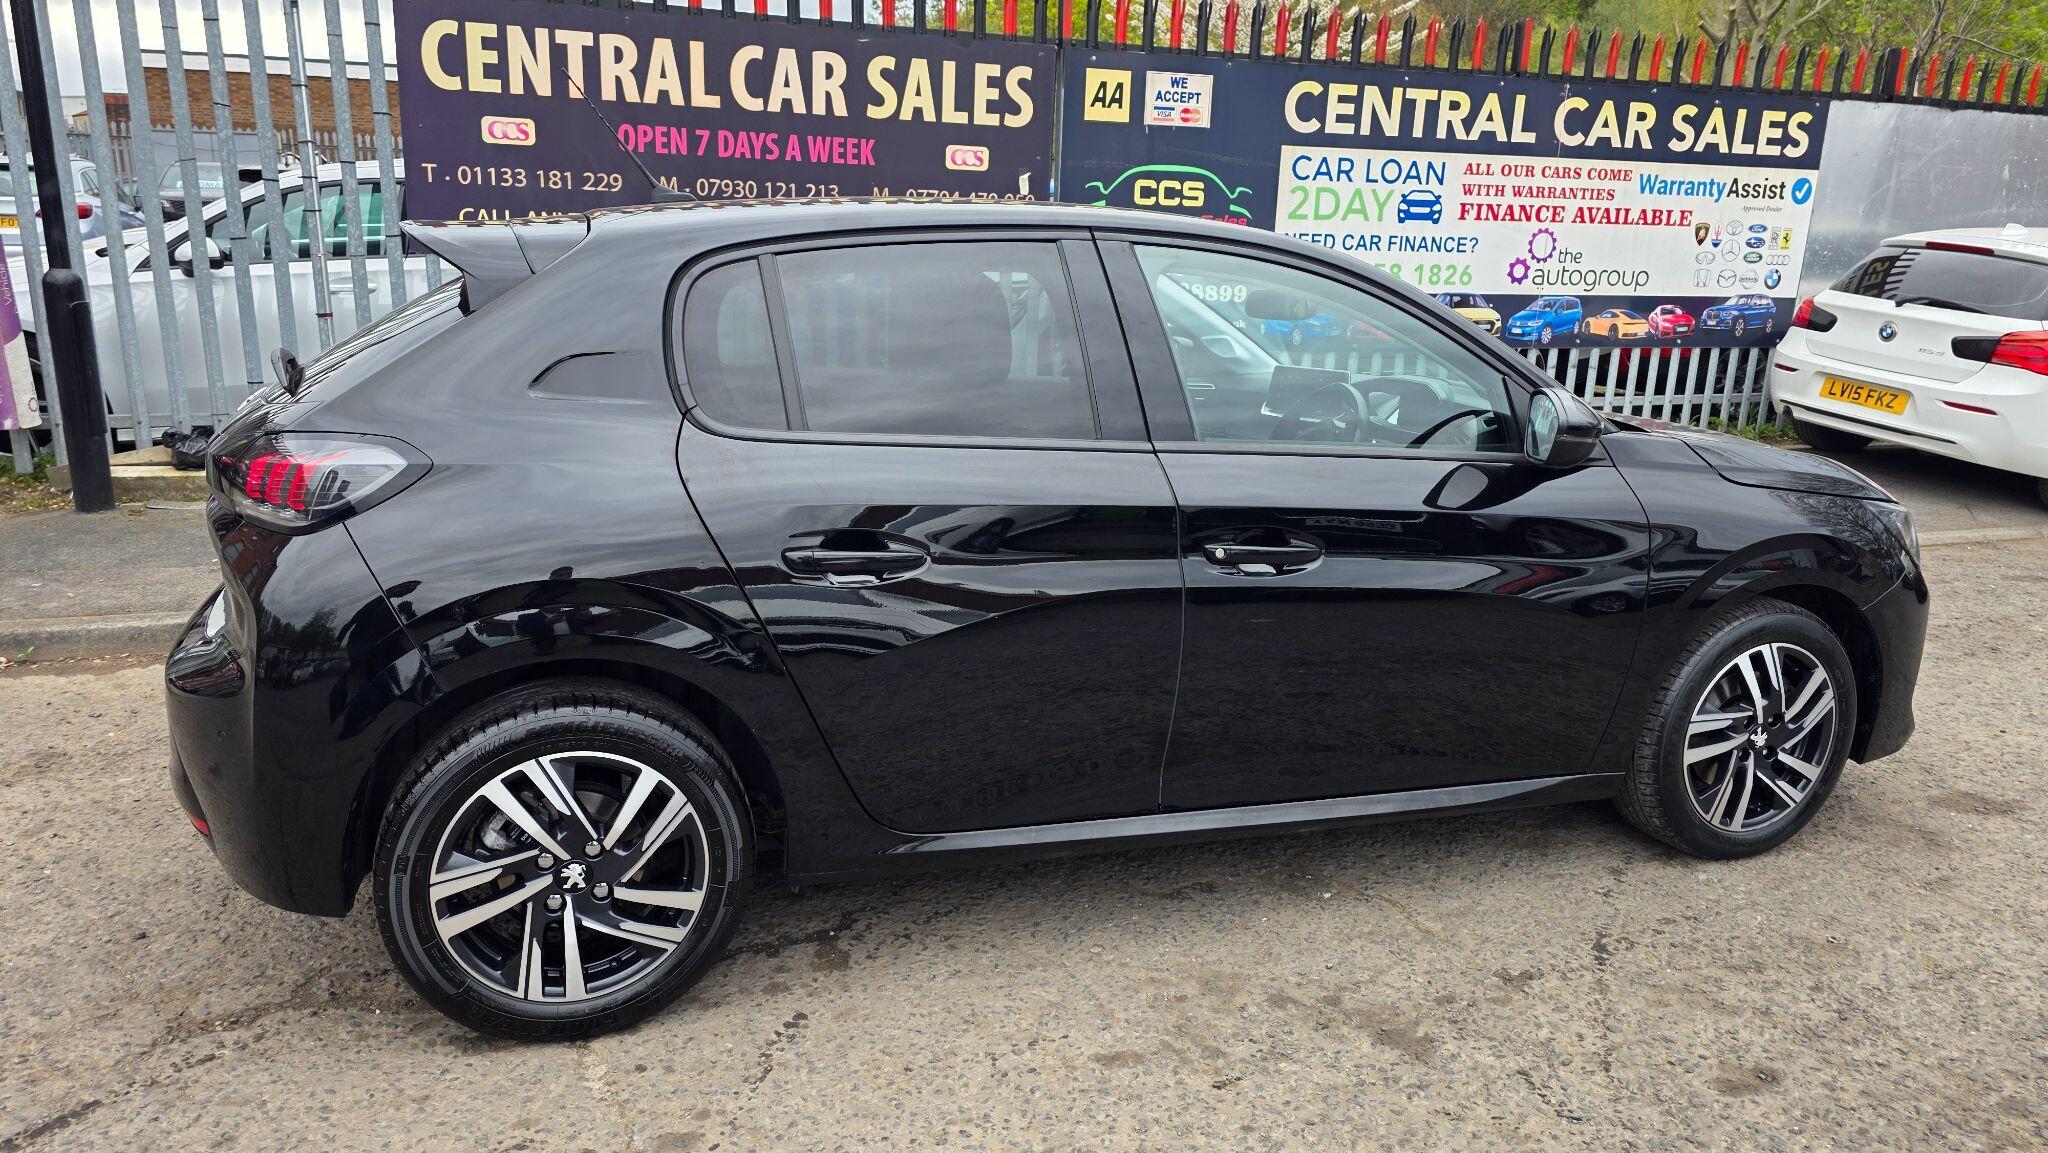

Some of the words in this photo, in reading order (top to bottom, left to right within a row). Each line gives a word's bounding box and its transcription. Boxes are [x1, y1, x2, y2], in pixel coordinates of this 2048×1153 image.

[421, 19, 721, 108] CENTRAL
[730, 45, 848, 117] CAR
[866, 55, 1034, 128] SALES
[1170, 77, 1188, 89] WE
[1090, 81, 1123, 109] AA
[1155, 90, 1201, 104] ACCEPT
[488, 121, 529, 141] CCS
[1284, 80, 1536, 144] CENTRAL
[1554, 97, 1657, 149] CAR
[1667, 103, 1814, 158] SALES
[618, 124, 688, 155] OPEN
[695, 130, 710, 156] 7
[718, 130, 778, 160] DAYS
[785, 134, 801, 162] A
[807, 136, 875, 165] WEEK
[950, 149, 984, 167] CCS
[1292, 155, 1354, 182] CAR
[1365, 159, 1446, 186] LOAN
[458, 166, 527, 187] 01133
[536, 170, 572, 190] 181
[582, 173, 623, 192] 229
[1463, 162, 1494, 177] ALL
[1501, 164, 1535, 178] OUR
[1541, 166, 1582, 180] CARS
[1587, 168, 1633, 182] COME
[696, 178, 757, 198] 07930
[764, 181, 796, 198] 121
[806, 183, 839, 198] 213
[1133, 179, 1205, 207] CCS
[1461, 183, 1505, 197] WITH
[1512, 185, 1616, 201] WARRANTIES
[1639, 174, 1786, 203] WarrantyAssist
[1287, 185, 1395, 222] 2DAY
[1458, 202, 1566, 223] FINANCE
[1571, 206, 1694, 227] AVAILABLE
[1342, 233, 1382, 251] CAR
[1387, 235, 1479, 253] FINANCE?
[1558, 247, 1583, 264] the
[1414, 264, 1473, 286] 1826
[1532, 265, 1649, 292] autogroup
[1828, 381, 1864, 401] LV15
[1865, 388, 1898, 409] FKZ
